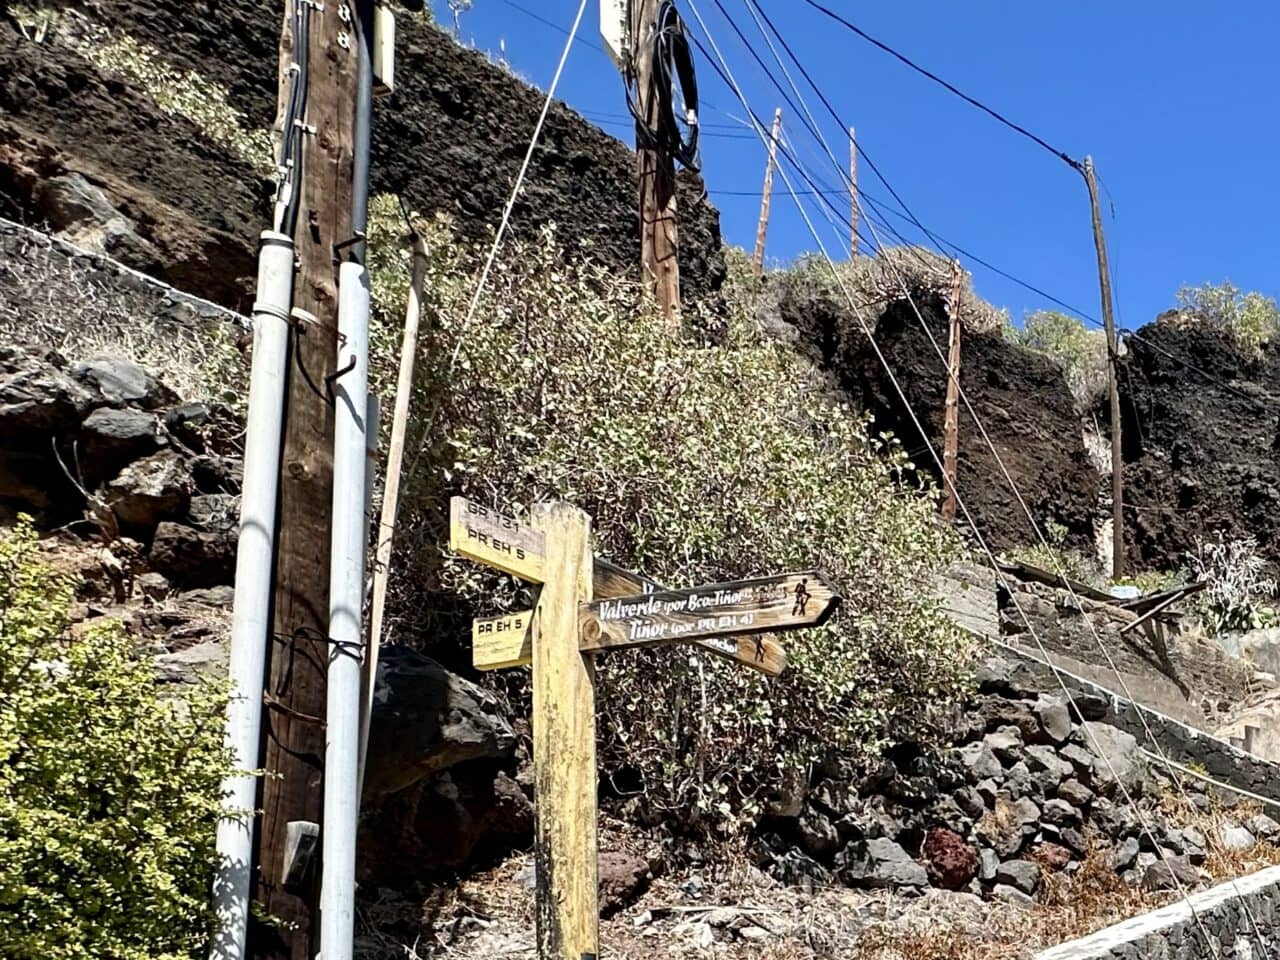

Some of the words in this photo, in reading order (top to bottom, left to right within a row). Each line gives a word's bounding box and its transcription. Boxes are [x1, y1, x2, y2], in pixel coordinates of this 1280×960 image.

[467, 502, 489, 518] GR
[495, 514, 519, 532] 131
[468, 528, 488, 544] PR
[493, 539, 511, 554] EH
[516, 548, 525, 560] 5
[600, 595, 661, 620] Valverde
[478, 623, 493, 635] PR
[497, 621, 511, 632] EH
[630, 620, 668, 640] Tiñor
[698, 617, 716, 630] PR
